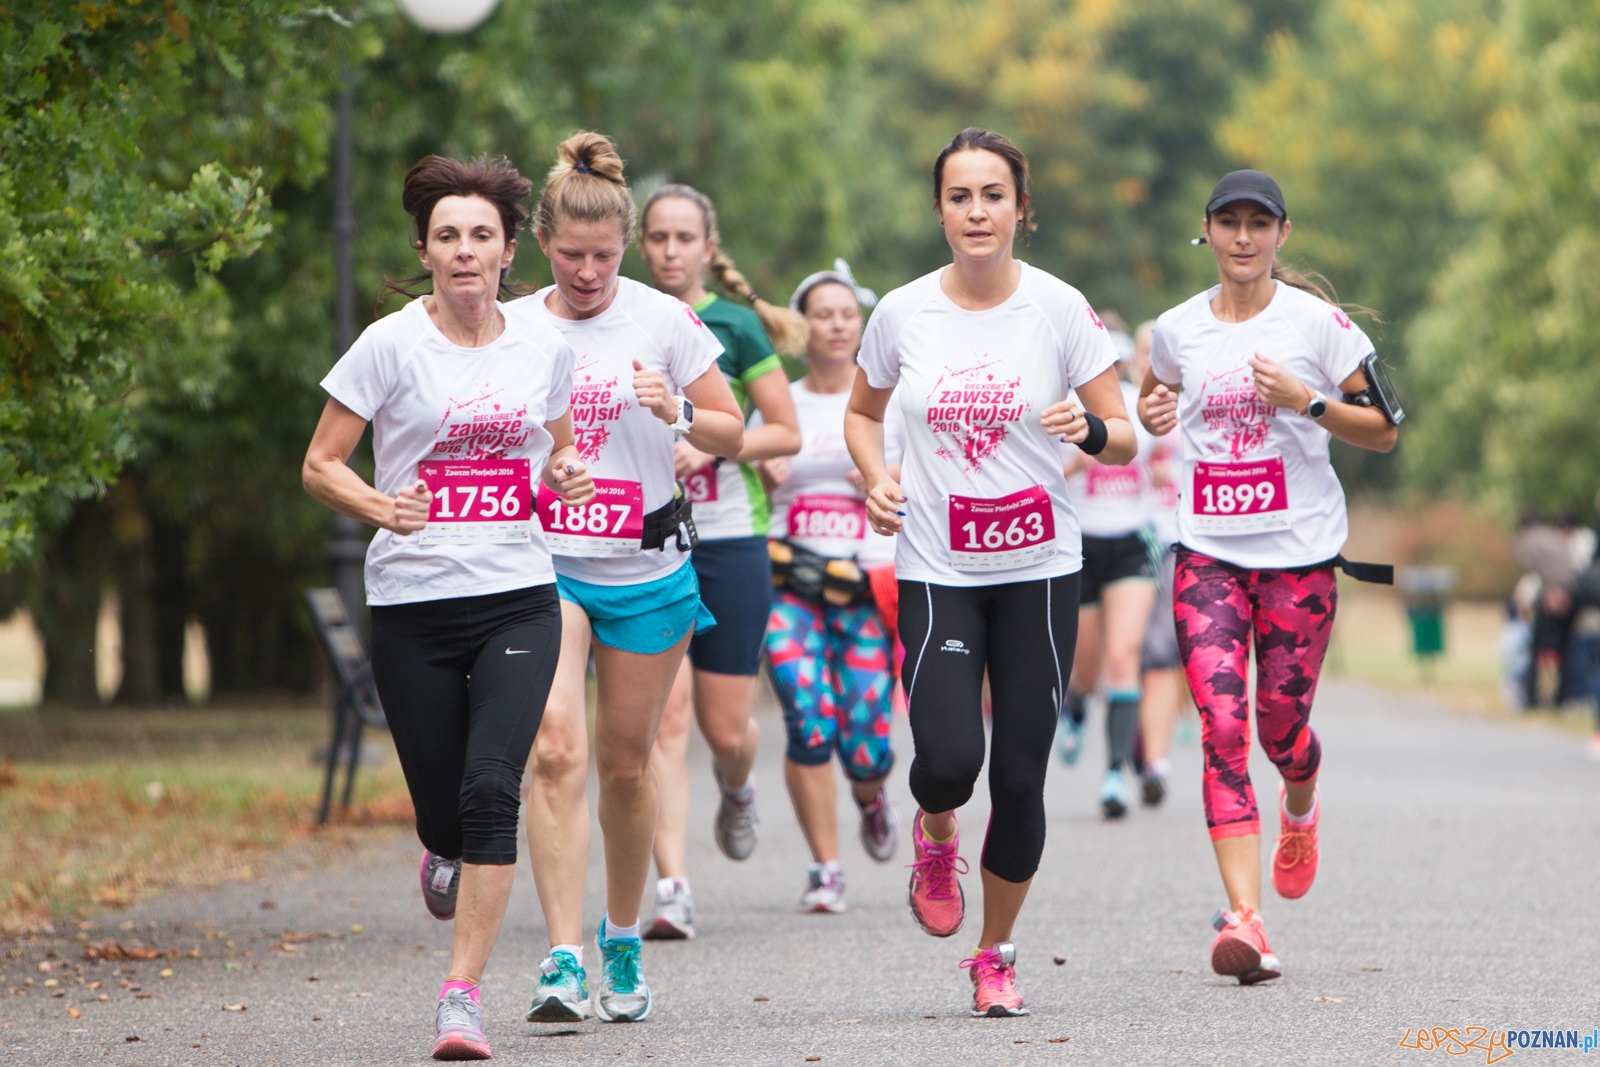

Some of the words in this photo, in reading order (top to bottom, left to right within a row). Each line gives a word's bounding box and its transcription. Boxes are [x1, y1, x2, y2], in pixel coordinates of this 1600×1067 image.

[939, 390, 1014, 404] zawsze
[927, 404, 1023, 426] pier(w)si!
[1209, 420, 1229, 430] 2016
[447, 420, 522, 438] zawsze
[933, 422, 960, 432] 2016
[609, 487, 625, 495] 2016
[1201, 481, 1275, 512] 1899
[434, 486, 520, 517] 1756
[971, 505, 994, 513] Zawsze
[548, 500, 631, 534] 1887
[794, 510, 860, 538] 1800
[962, 512, 1044, 548] 1663
